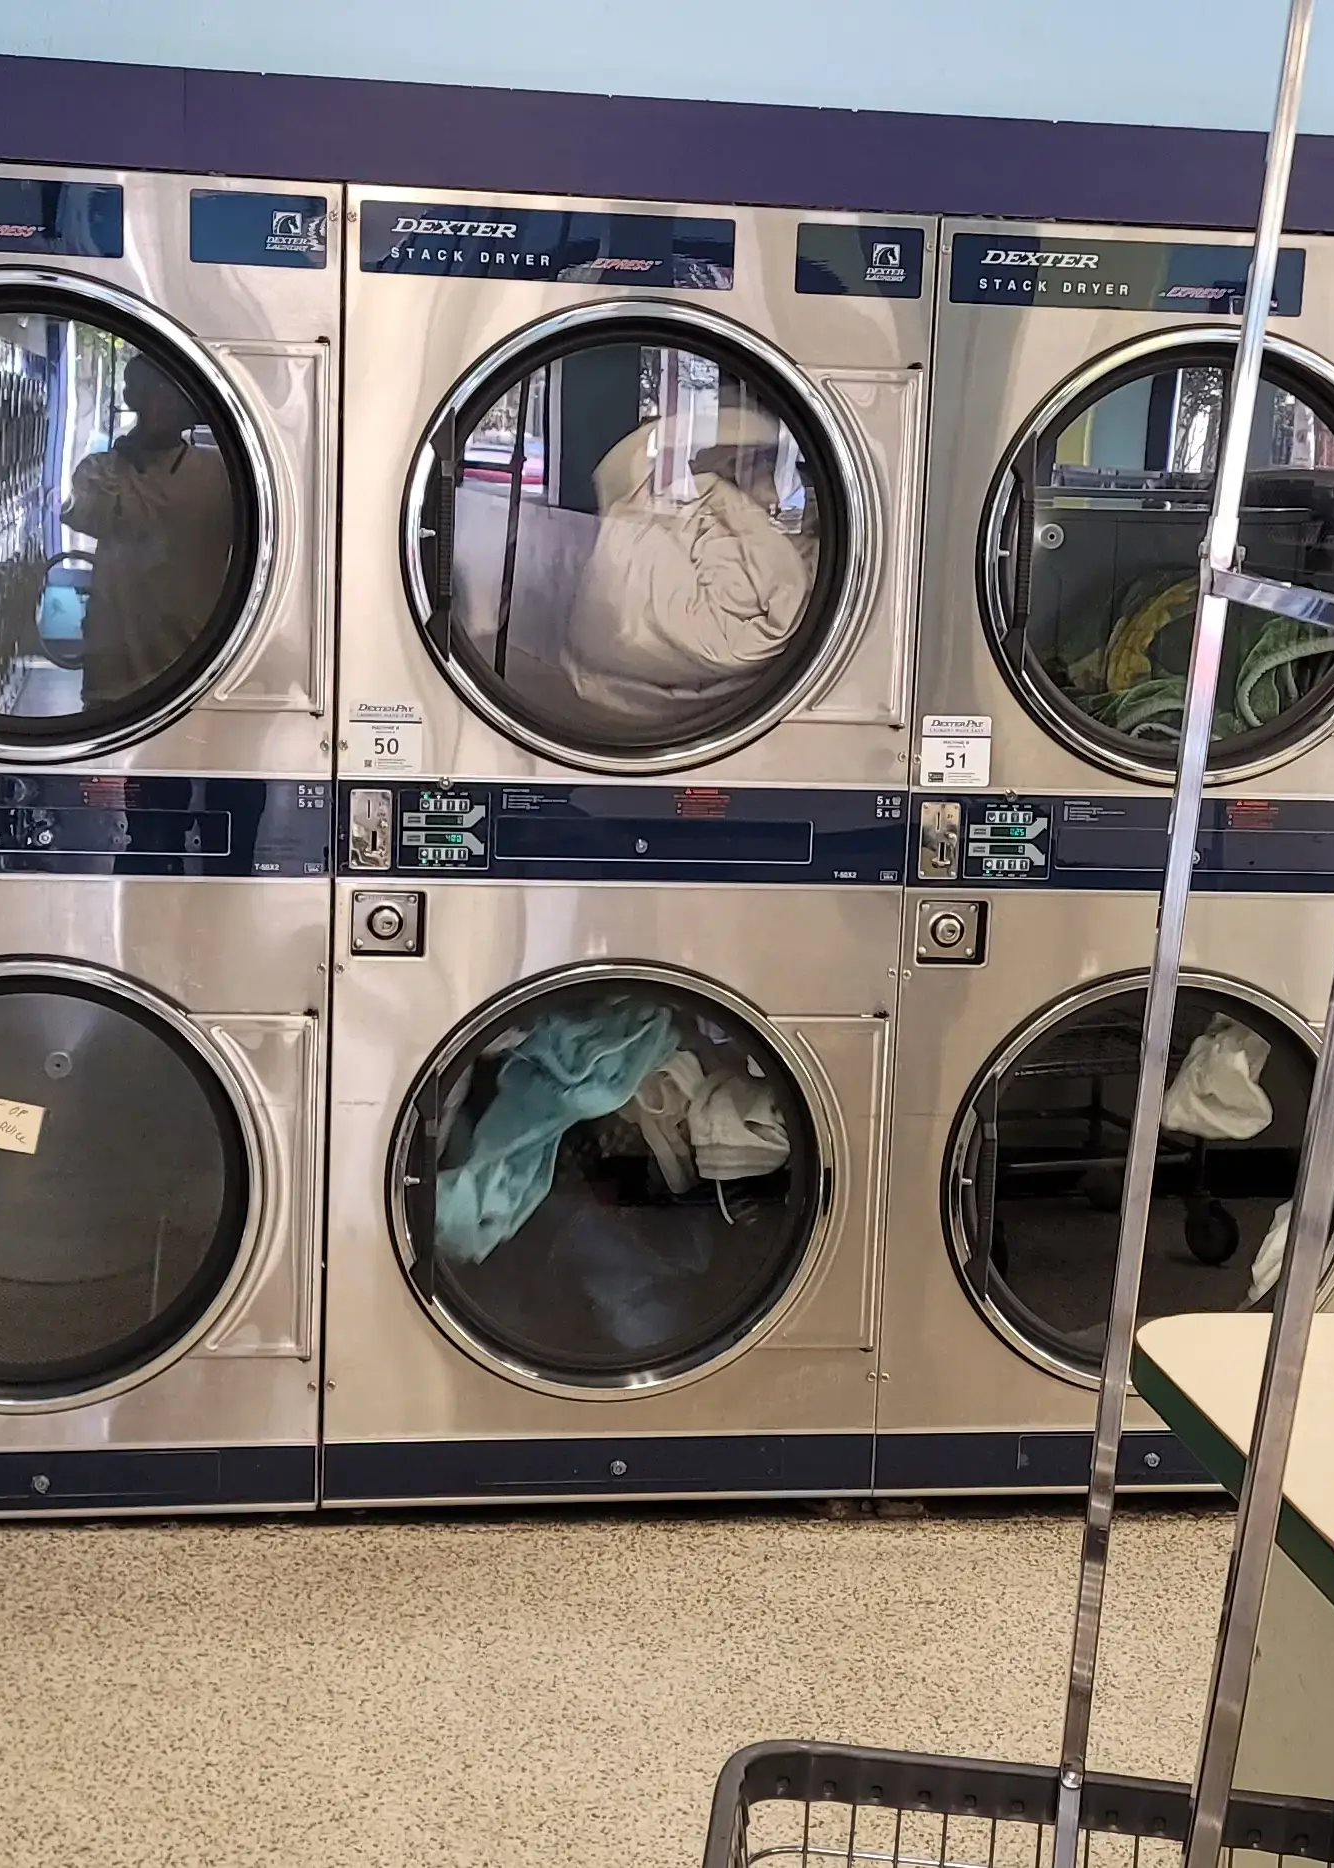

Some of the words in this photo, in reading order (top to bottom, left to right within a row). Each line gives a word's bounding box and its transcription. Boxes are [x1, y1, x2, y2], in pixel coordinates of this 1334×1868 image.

[390, 217, 517, 239] DEXTER
[266, 236, 308, 245] DEXTER
[390, 247, 464, 262] STACK
[480, 252, 551, 267] DRYER
[980, 250, 1100, 269] DEXTER
[590, 258, 655, 271] EXPRESS
[866, 267, 905, 275] DEXTER
[979, 278, 1048, 292] STACK
[1063, 282, 1129, 296] DRYER
[1166, 286, 1226, 299] EXPRESS
[374, 737, 399, 755] 50
[945, 752, 966, 769] 51
[298, 785, 306, 795] 5
[298, 798, 306, 808] 5
[876, 795, 884, 805] 5
[876, 808, 883, 818] 5
[8, 1106, 29, 1118] OF
